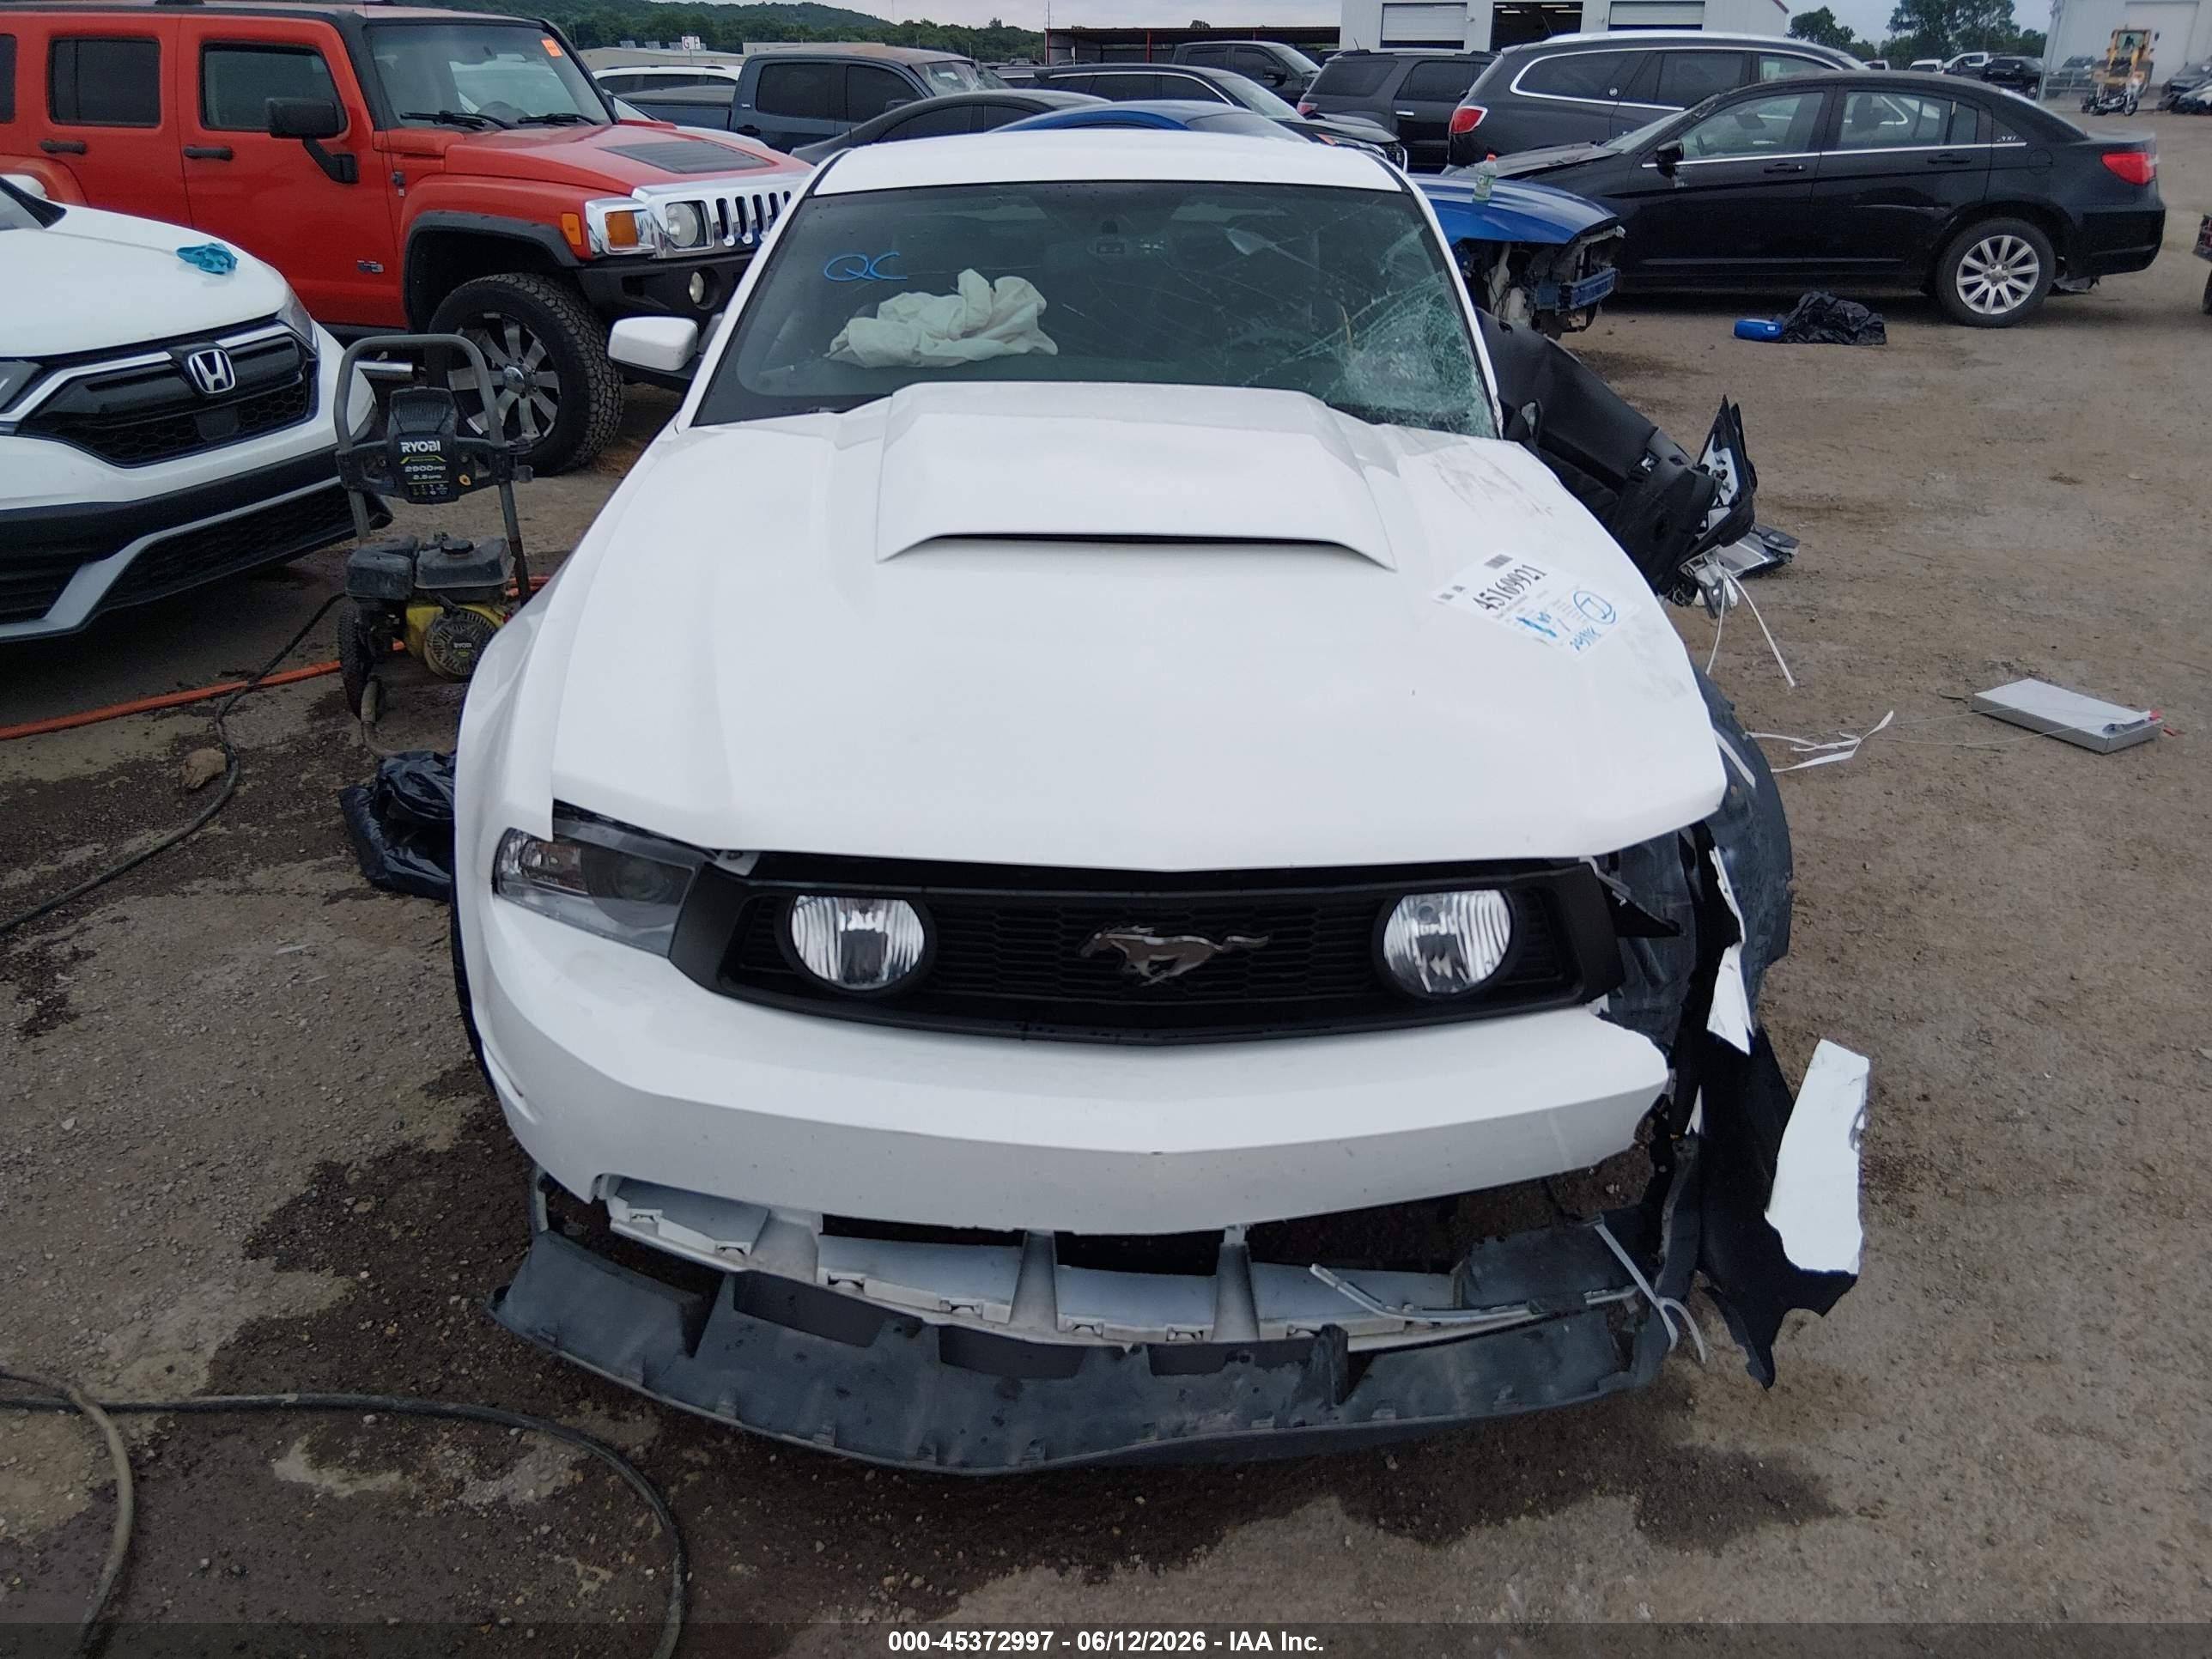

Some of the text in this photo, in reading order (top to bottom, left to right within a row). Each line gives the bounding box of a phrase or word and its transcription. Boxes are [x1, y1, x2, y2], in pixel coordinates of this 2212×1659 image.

[683, 37, 690, 49] G
[823, 251, 908, 281] QC
[400, 440, 441, 453] RYOBI
[1473, 564, 1547, 611] 45169921
